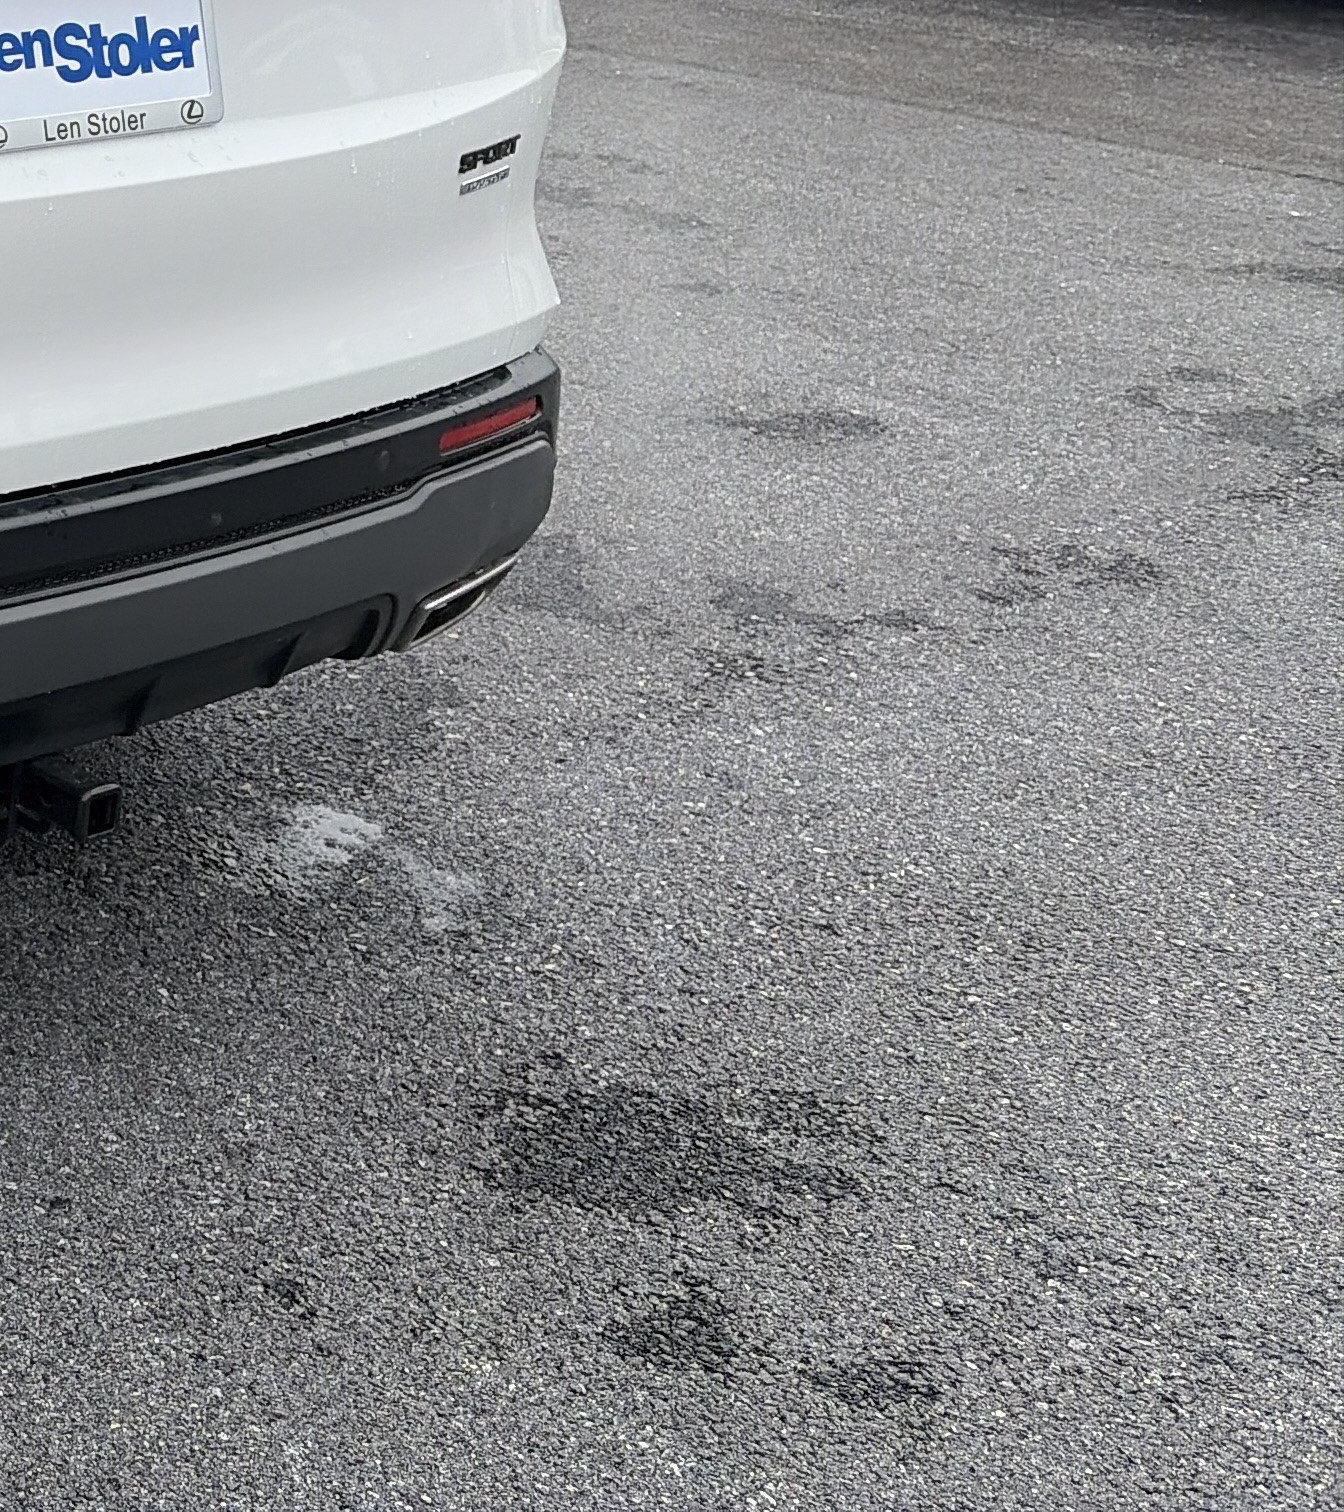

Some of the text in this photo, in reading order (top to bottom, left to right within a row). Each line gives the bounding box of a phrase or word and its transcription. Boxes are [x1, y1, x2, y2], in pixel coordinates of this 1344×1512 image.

[42, 109, 148, 142] Len Stoler
[458, 133, 521, 174] SPORT
